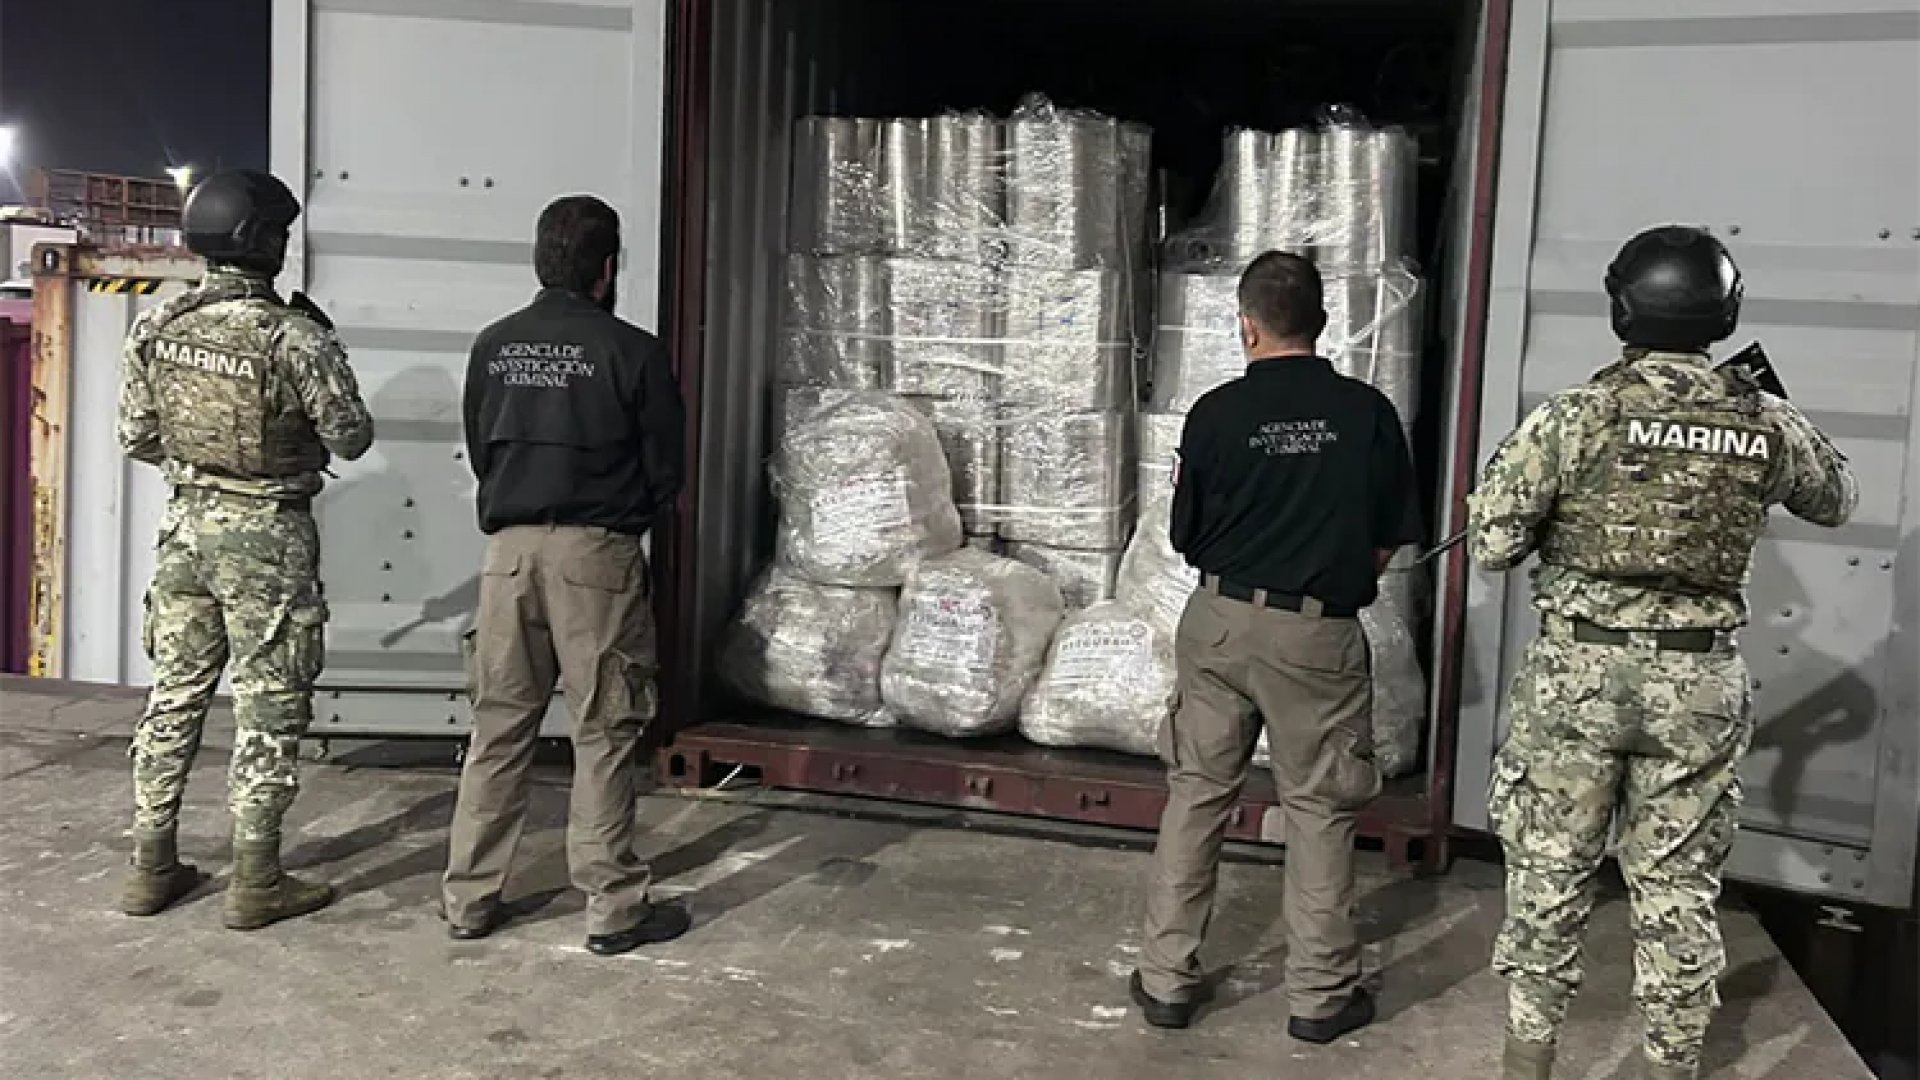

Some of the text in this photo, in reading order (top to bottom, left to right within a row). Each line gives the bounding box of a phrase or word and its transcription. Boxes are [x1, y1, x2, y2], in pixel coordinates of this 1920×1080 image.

[155, 340, 255, 379] MARINA
[497, 343, 584, 358] AGENCIA DE
[504, 374, 568, 387] CRIMINAL
[1627, 419, 1769, 459] MARINA
